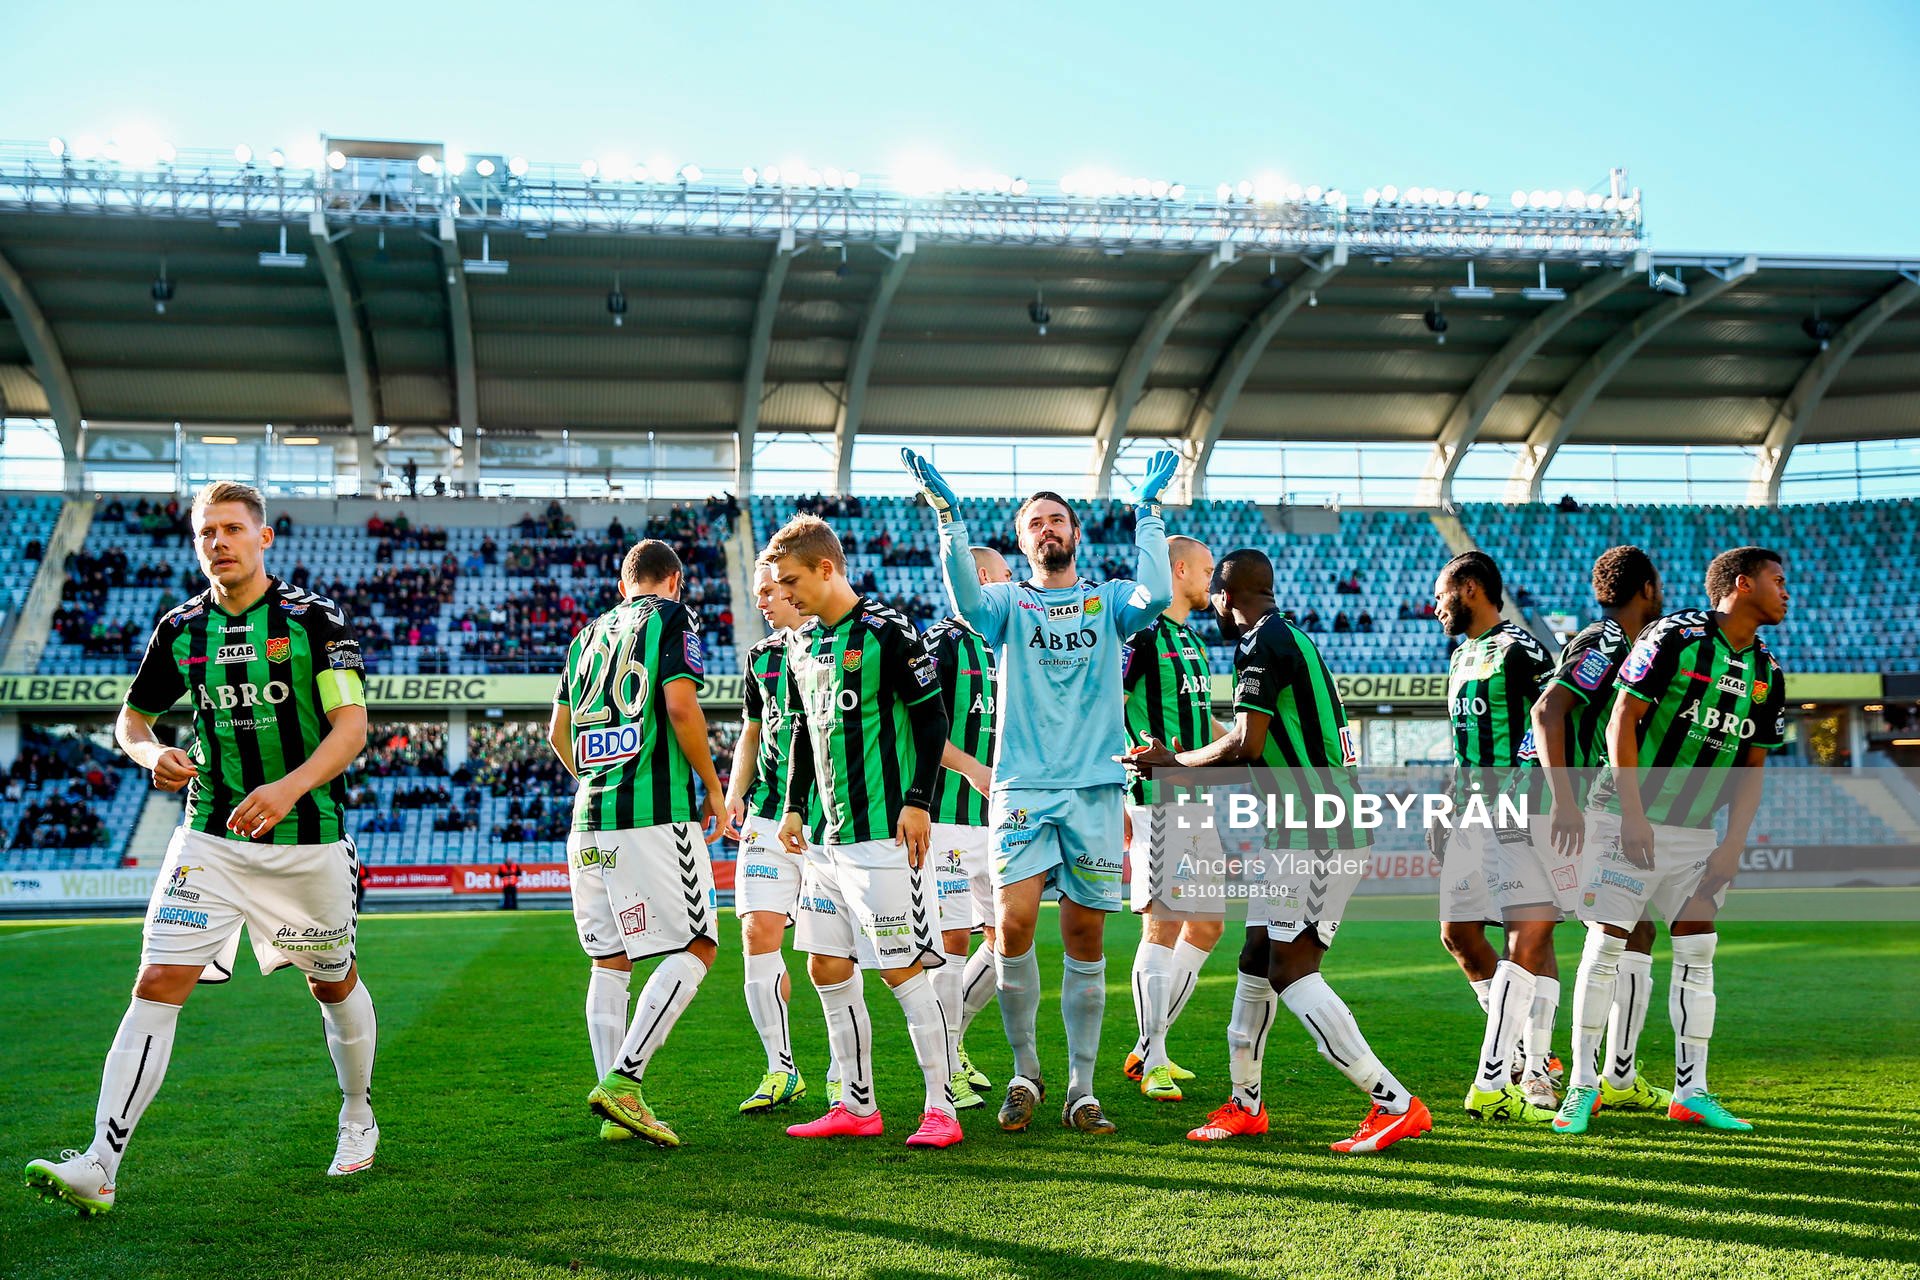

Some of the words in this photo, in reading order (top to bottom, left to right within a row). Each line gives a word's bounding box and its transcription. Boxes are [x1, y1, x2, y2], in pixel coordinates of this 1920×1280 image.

[1049, 605, 1079, 616] SKAB
[218, 623, 254, 634] hummel
[1029, 625, 1097, 651] ÅBRO
[218, 646, 254, 658] SKAB
[574, 634, 649, 727] 26
[1719, 676, 1746, 691] SKAB
[198, 681, 290, 710] ÅBRO
[1679, 698, 1756, 739] ÅBRO
[589, 727, 637, 758] BDO
[464, 871, 492, 889] Det
[155, 906, 209, 926] YGGFOKUS
[276, 925, 297, 939] Åke
[301, 921, 349, 937] Ekstrand
[897, 926, 911, 935] AB
[880, 944, 911, 956] hummel
[313, 957, 348, 970] hummel
